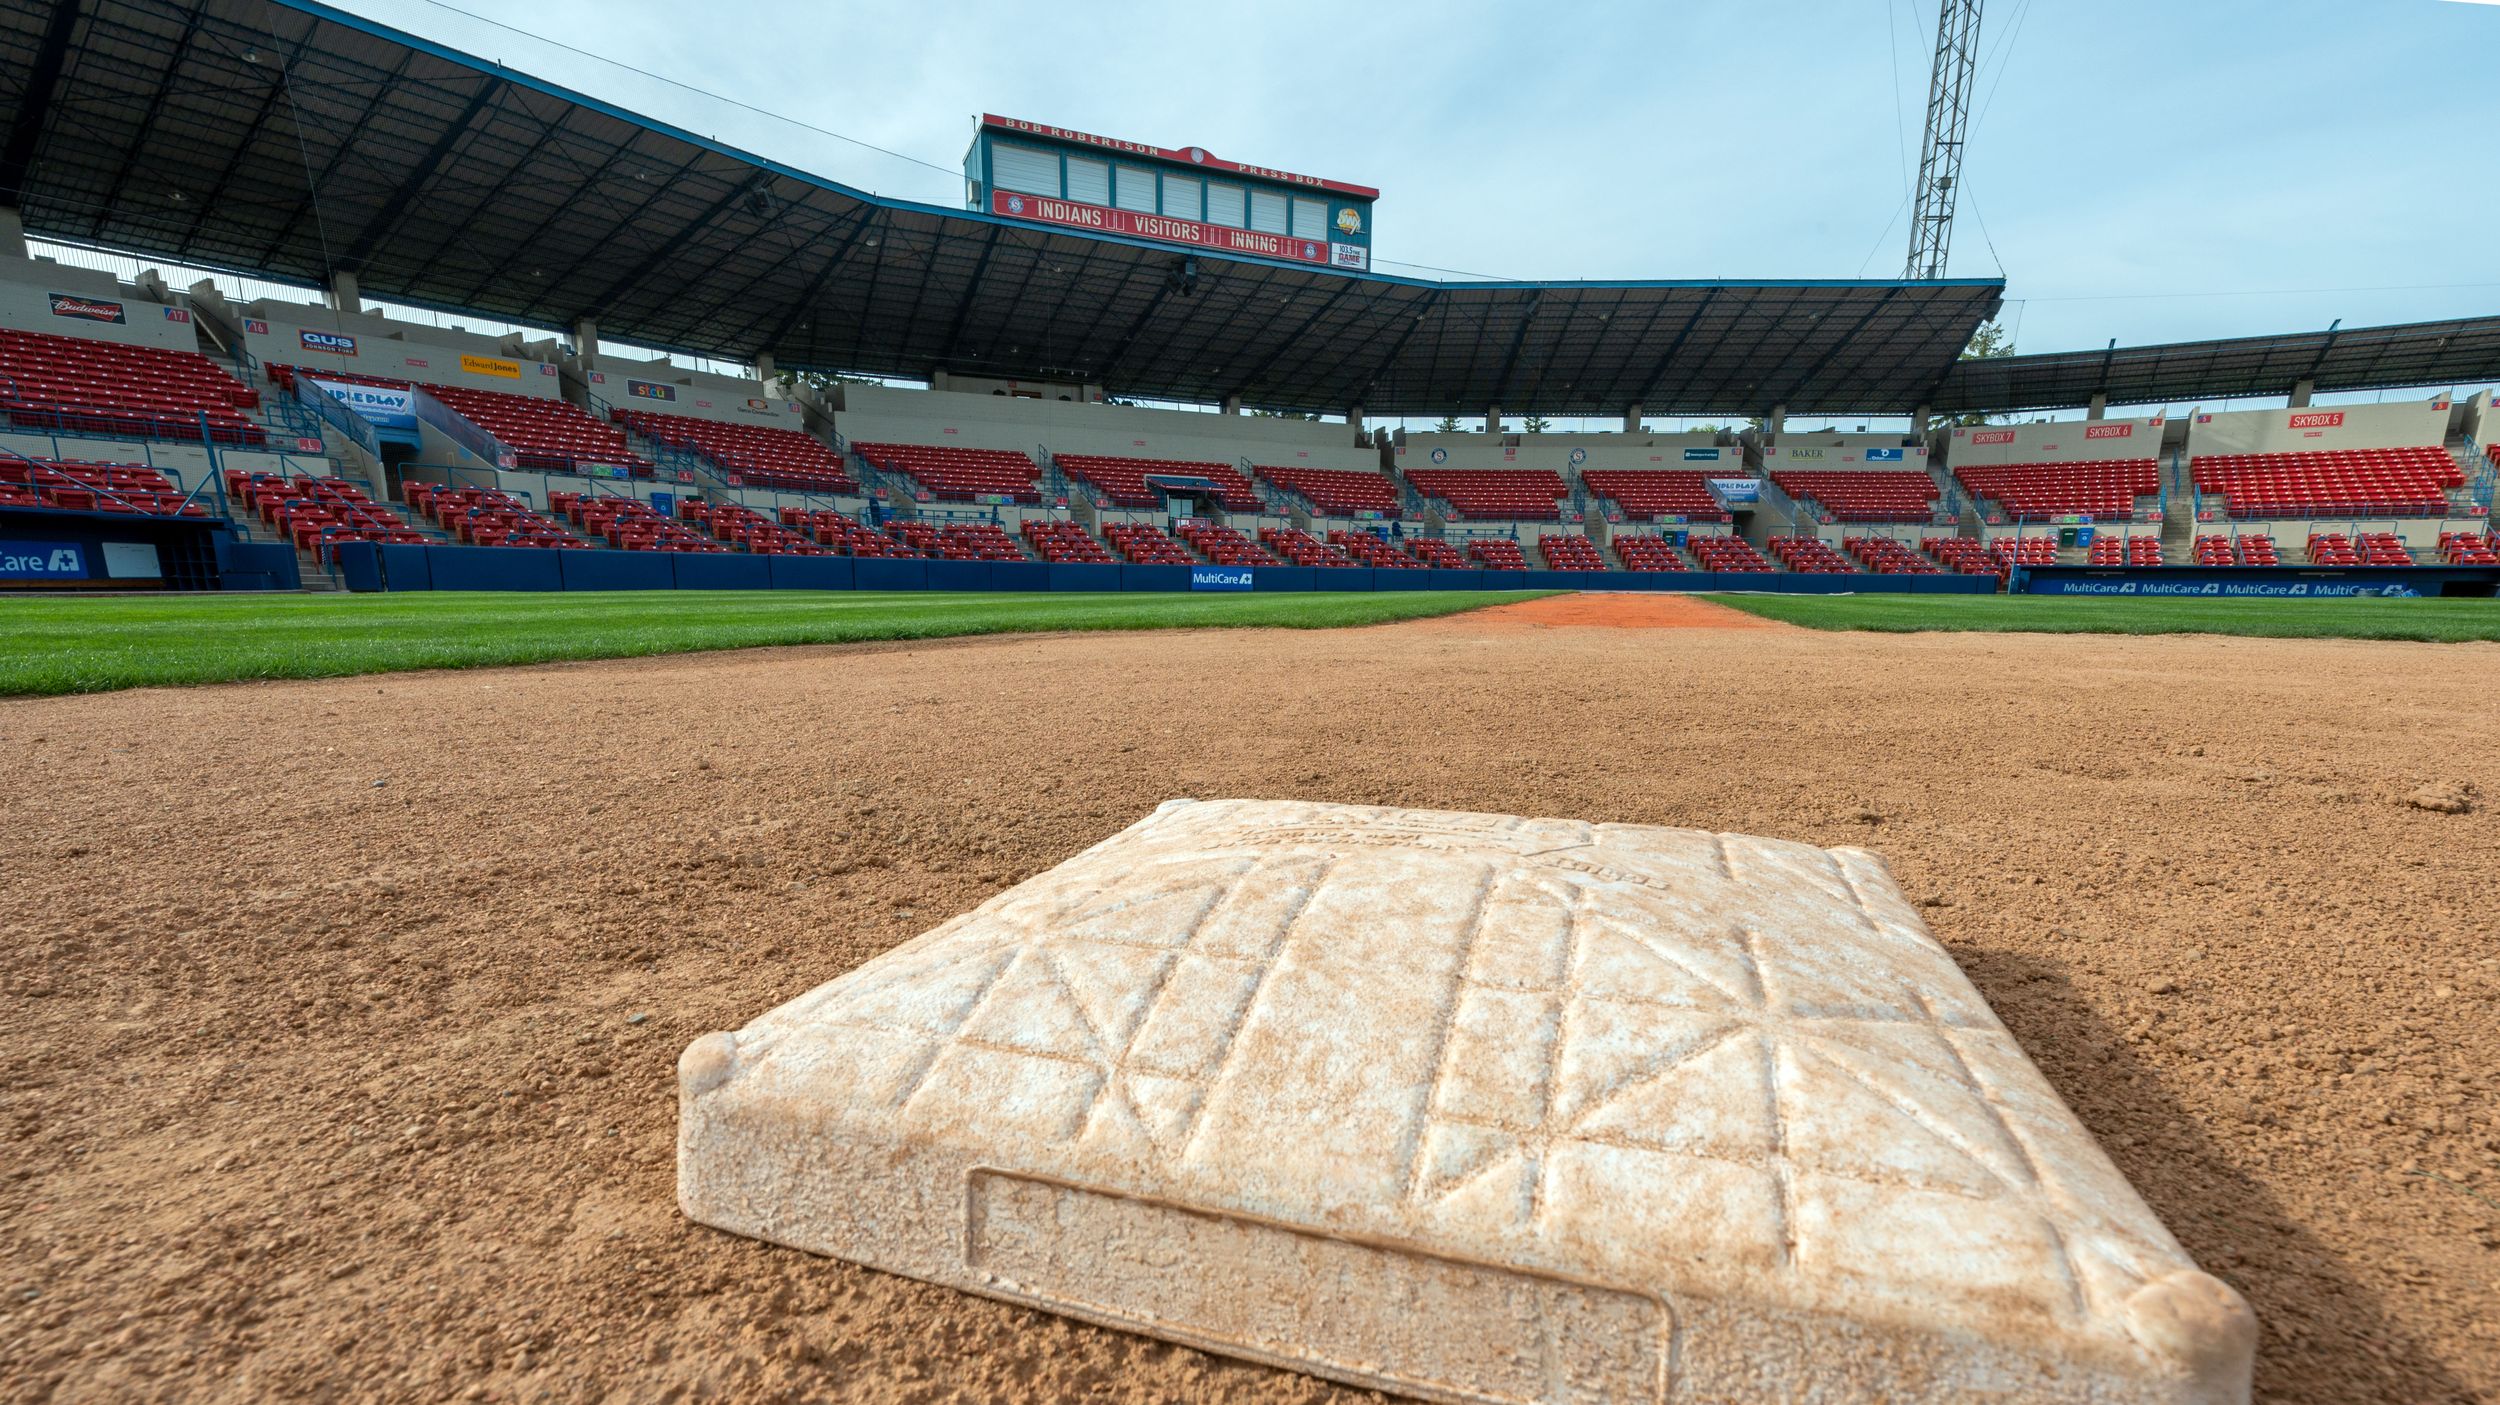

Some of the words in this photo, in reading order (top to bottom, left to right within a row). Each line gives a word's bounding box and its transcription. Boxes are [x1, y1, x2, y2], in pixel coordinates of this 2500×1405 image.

[1005, 118, 1043, 132] BOB
[1051, 127, 1159, 155] ROBERTSON
[1238, 163, 1289, 180] PRESS
[1295, 174, 1324, 187] BOX
[1037, 200, 1102, 226] INDIANS
[1134, 214, 1200, 241] VISITORS
[1231, 231, 1278, 253] INNING
[50, 299, 122, 318] Budweiser
[172, 310, 183, 321] 17
[253, 321, 264, 333] 16
[303, 332, 354, 348] GUS
[305, 343, 336, 352] JOHNSON
[463, 358, 493, 371] Edward
[494, 362, 518, 374] Jones
[638, 384, 665, 399] stcu
[365, 393, 406, 409] PLAY
[2293, 415, 2331, 427] SKYBOX
[2332, 414, 2339, 425] 5
[1975, 433, 2005, 443] SKYBOX
[2006, 432, 2012, 441] 7
[2089, 425, 2121, 438] SKYBOX
[2123, 426, 2128, 436] 6
[1791, 449, 1824, 458] BAKER
[1193, 573, 1239, 584] MultiCare
[2063, 583, 2118, 593] MultiCare
[2142, 583, 2200, 594] MultiCare
[2225, 584, 2287, 595] MultiCare
